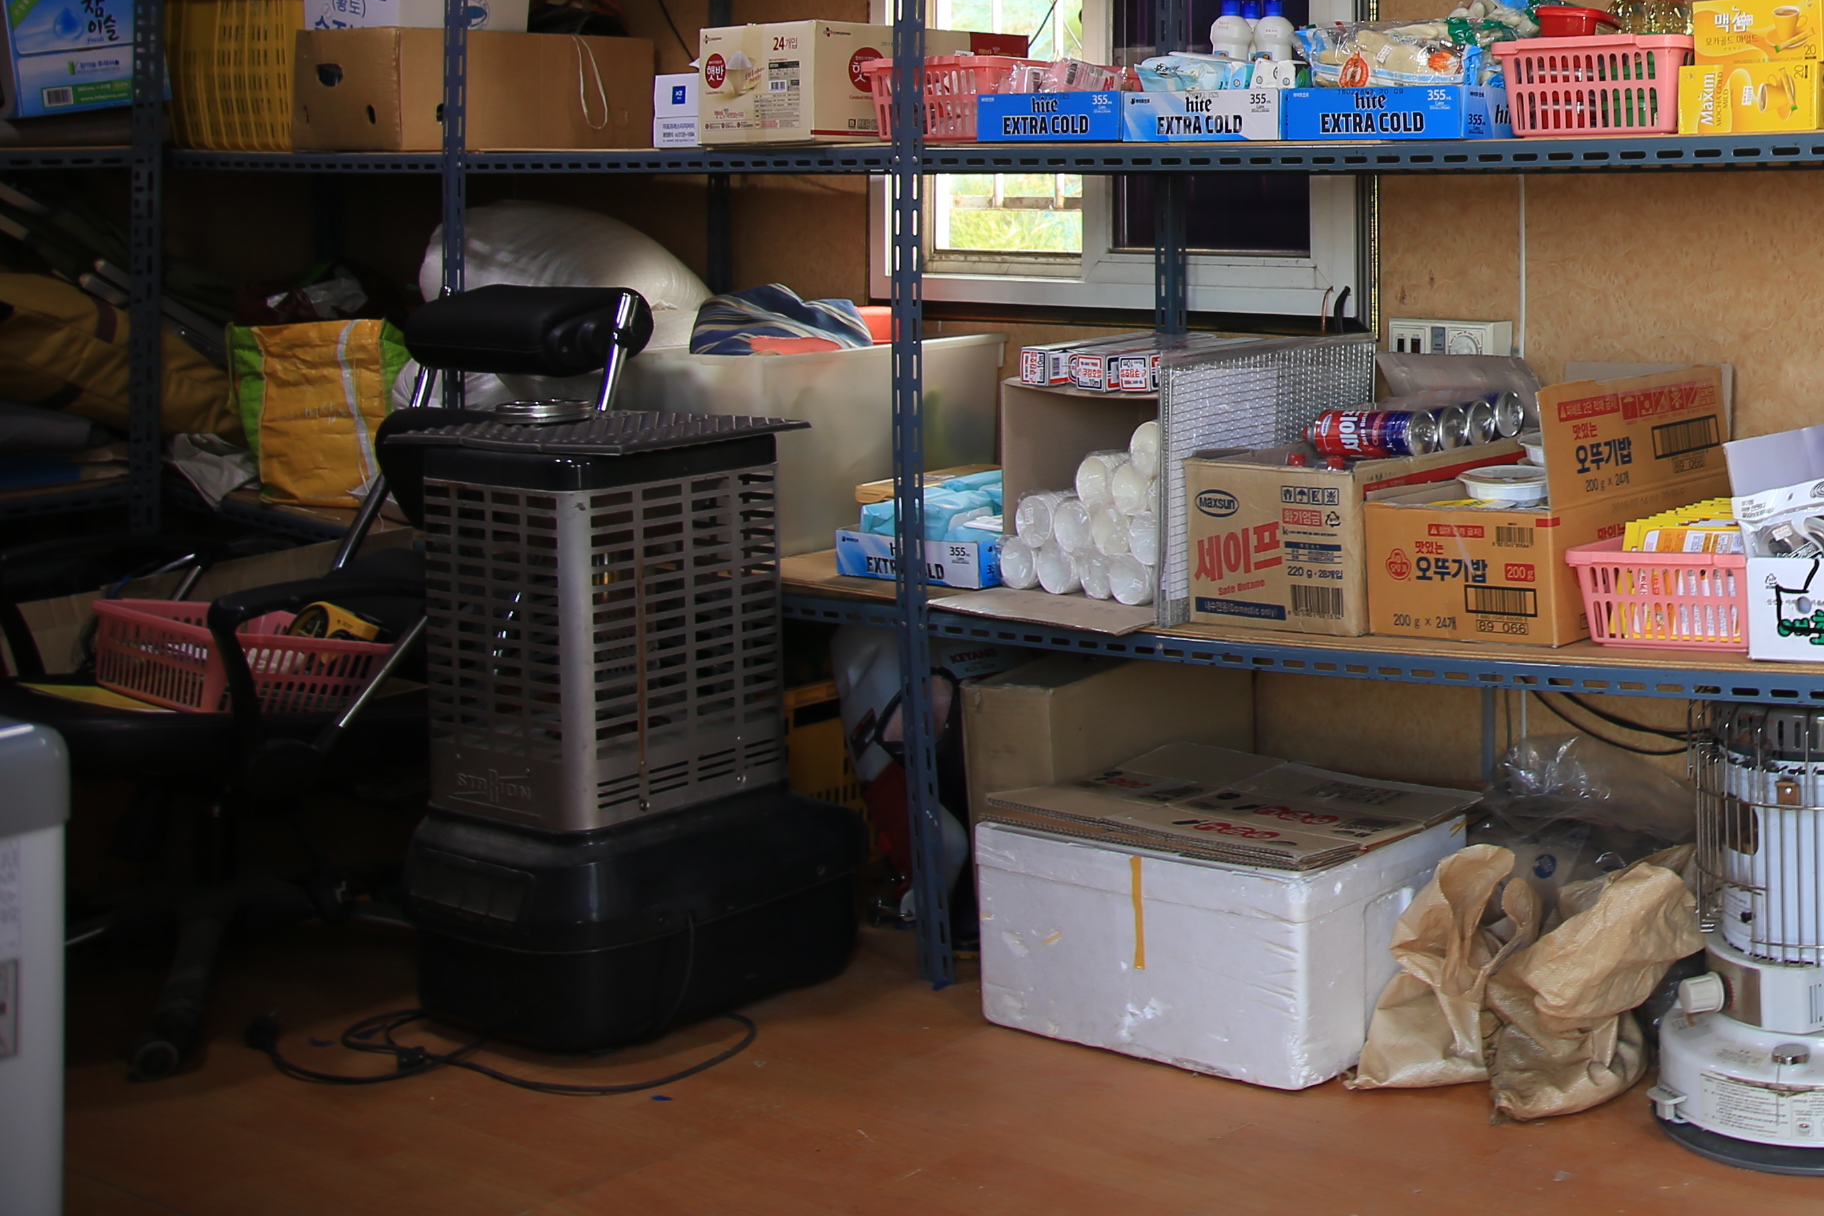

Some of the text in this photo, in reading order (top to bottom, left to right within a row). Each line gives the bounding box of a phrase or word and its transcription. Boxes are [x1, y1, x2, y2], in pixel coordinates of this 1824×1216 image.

[88, 14, 119, 41] 이슬
[773, 36, 798, 51] 24개입
[1705, 34, 1759, 46] 모카골드 마일드
[1803, 43, 1817, 56] 20
[707, 65, 724, 81] 햇반
[1793, 64, 1805, 80] 20
[1716, 71, 1724, 93] GOLD
[1031, 96, 1059, 113] hite
[1185, 95, 1213, 113] hite
[1354, 92, 1387, 110] hite
[1698, 72, 1716, 126] Maxim
[1003, 116, 1089, 135] EXTRA COLD
[1157, 115, 1243, 135] EXTRA COLD
[1319, 112, 1425, 135] EXTRA COLD
[1572, 422, 1597, 440] 맛있는
[1576, 437, 1632, 474] 오뚜기밥
[1585, 478, 1599, 492] 200
[1615, 471, 1630, 485] 24개
[1200, 496, 1236, 510] Maxsun
[1284, 510, 1321, 526] 화기엄금
[1194, 521, 1283, 582] 세이프
[1415, 541, 1444, 555] 맛있는
[1287, 565, 1343, 580] 220 g 28개입
[1416, 556, 1488, 583] 오뚜기밥
[1507, 566, 1535, 581] 200 g
[1218, 579, 1266, 596] Safe Butane
[1393, 613, 1457, 630] 200 g 24개
[1478, 621, 1527, 634] 89 066
[950, 648, 998, 664] KEYANG
